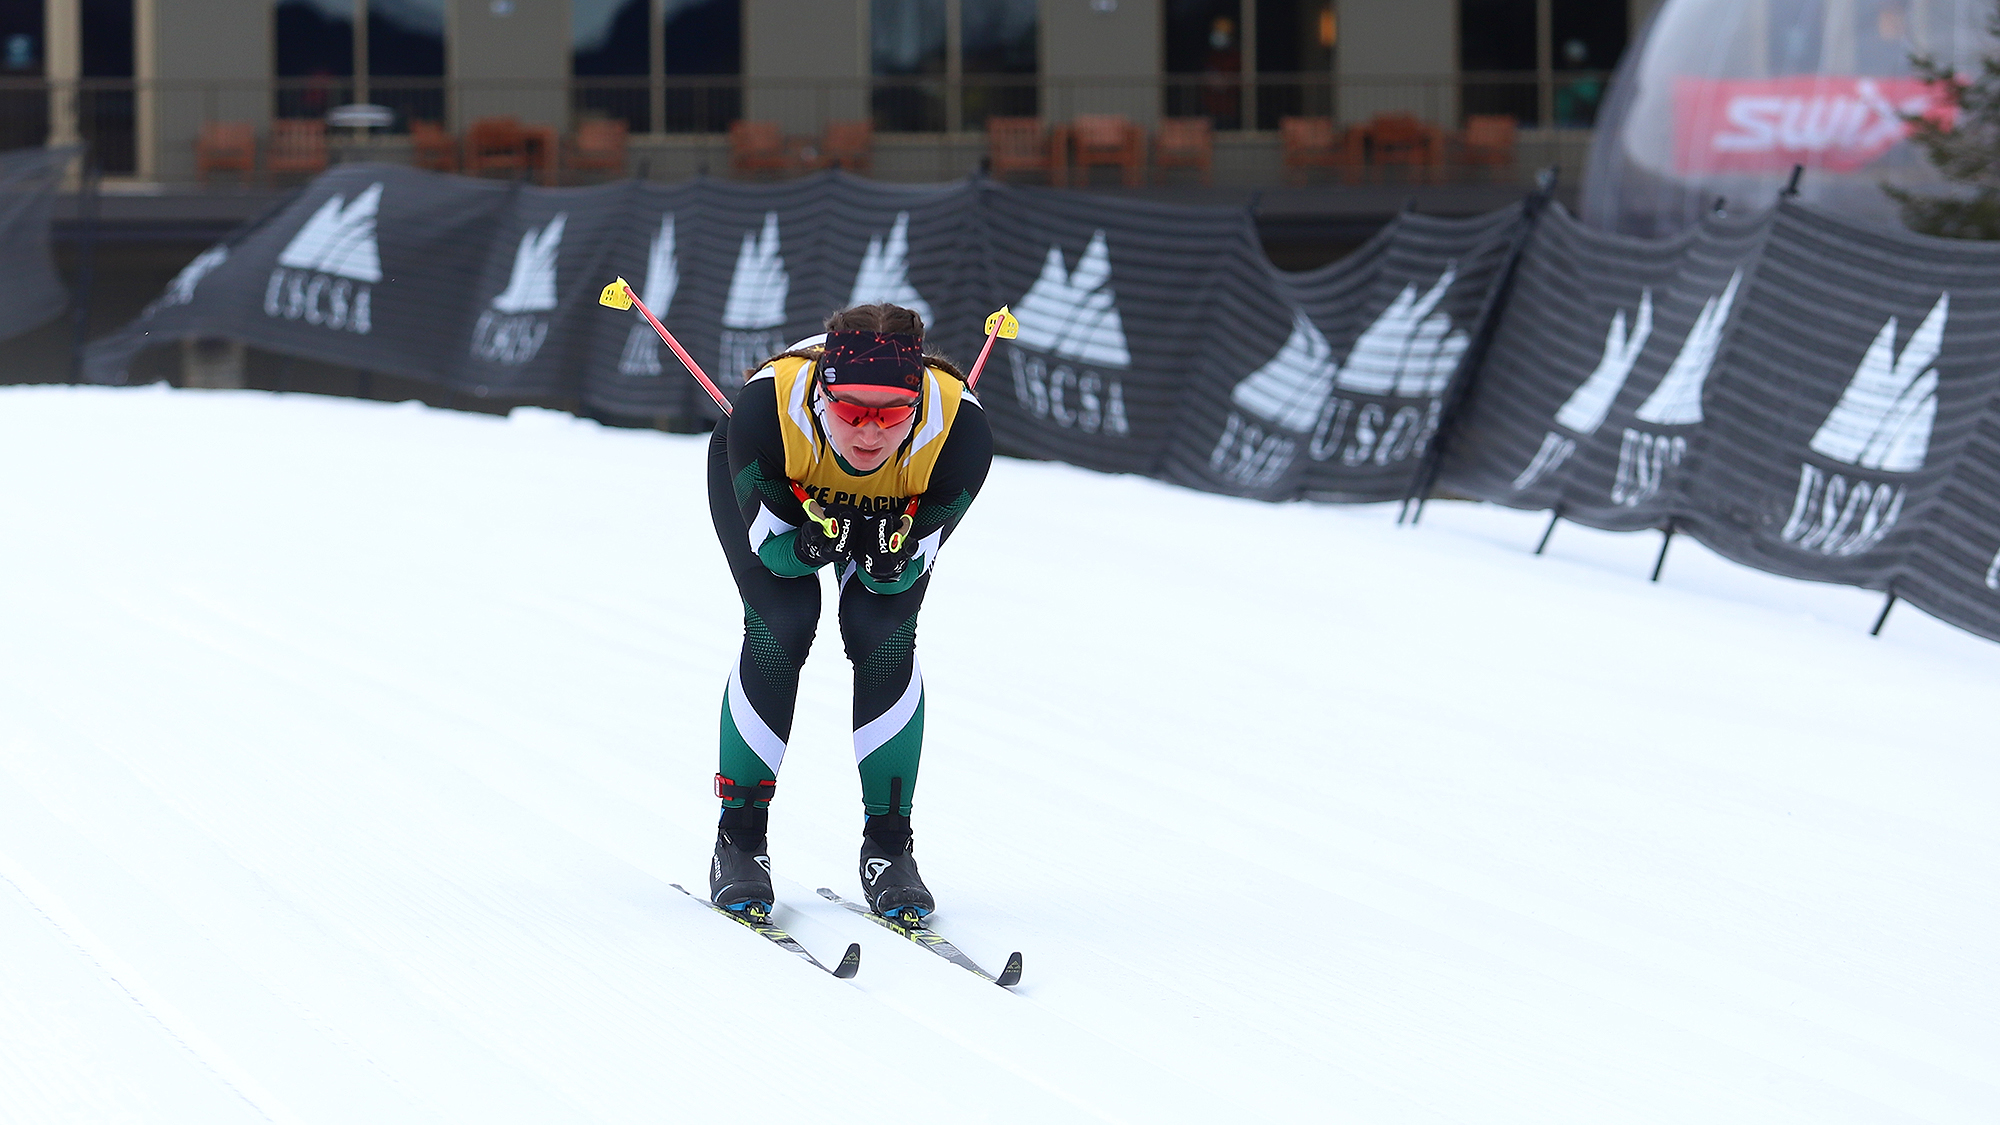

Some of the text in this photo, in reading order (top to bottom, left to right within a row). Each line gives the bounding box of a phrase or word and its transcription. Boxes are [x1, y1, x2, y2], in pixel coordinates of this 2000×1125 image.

[804, 484, 831, 508] KE
[835, 518, 851, 553] Roeckl
[878, 518, 889, 554] Roeckl
